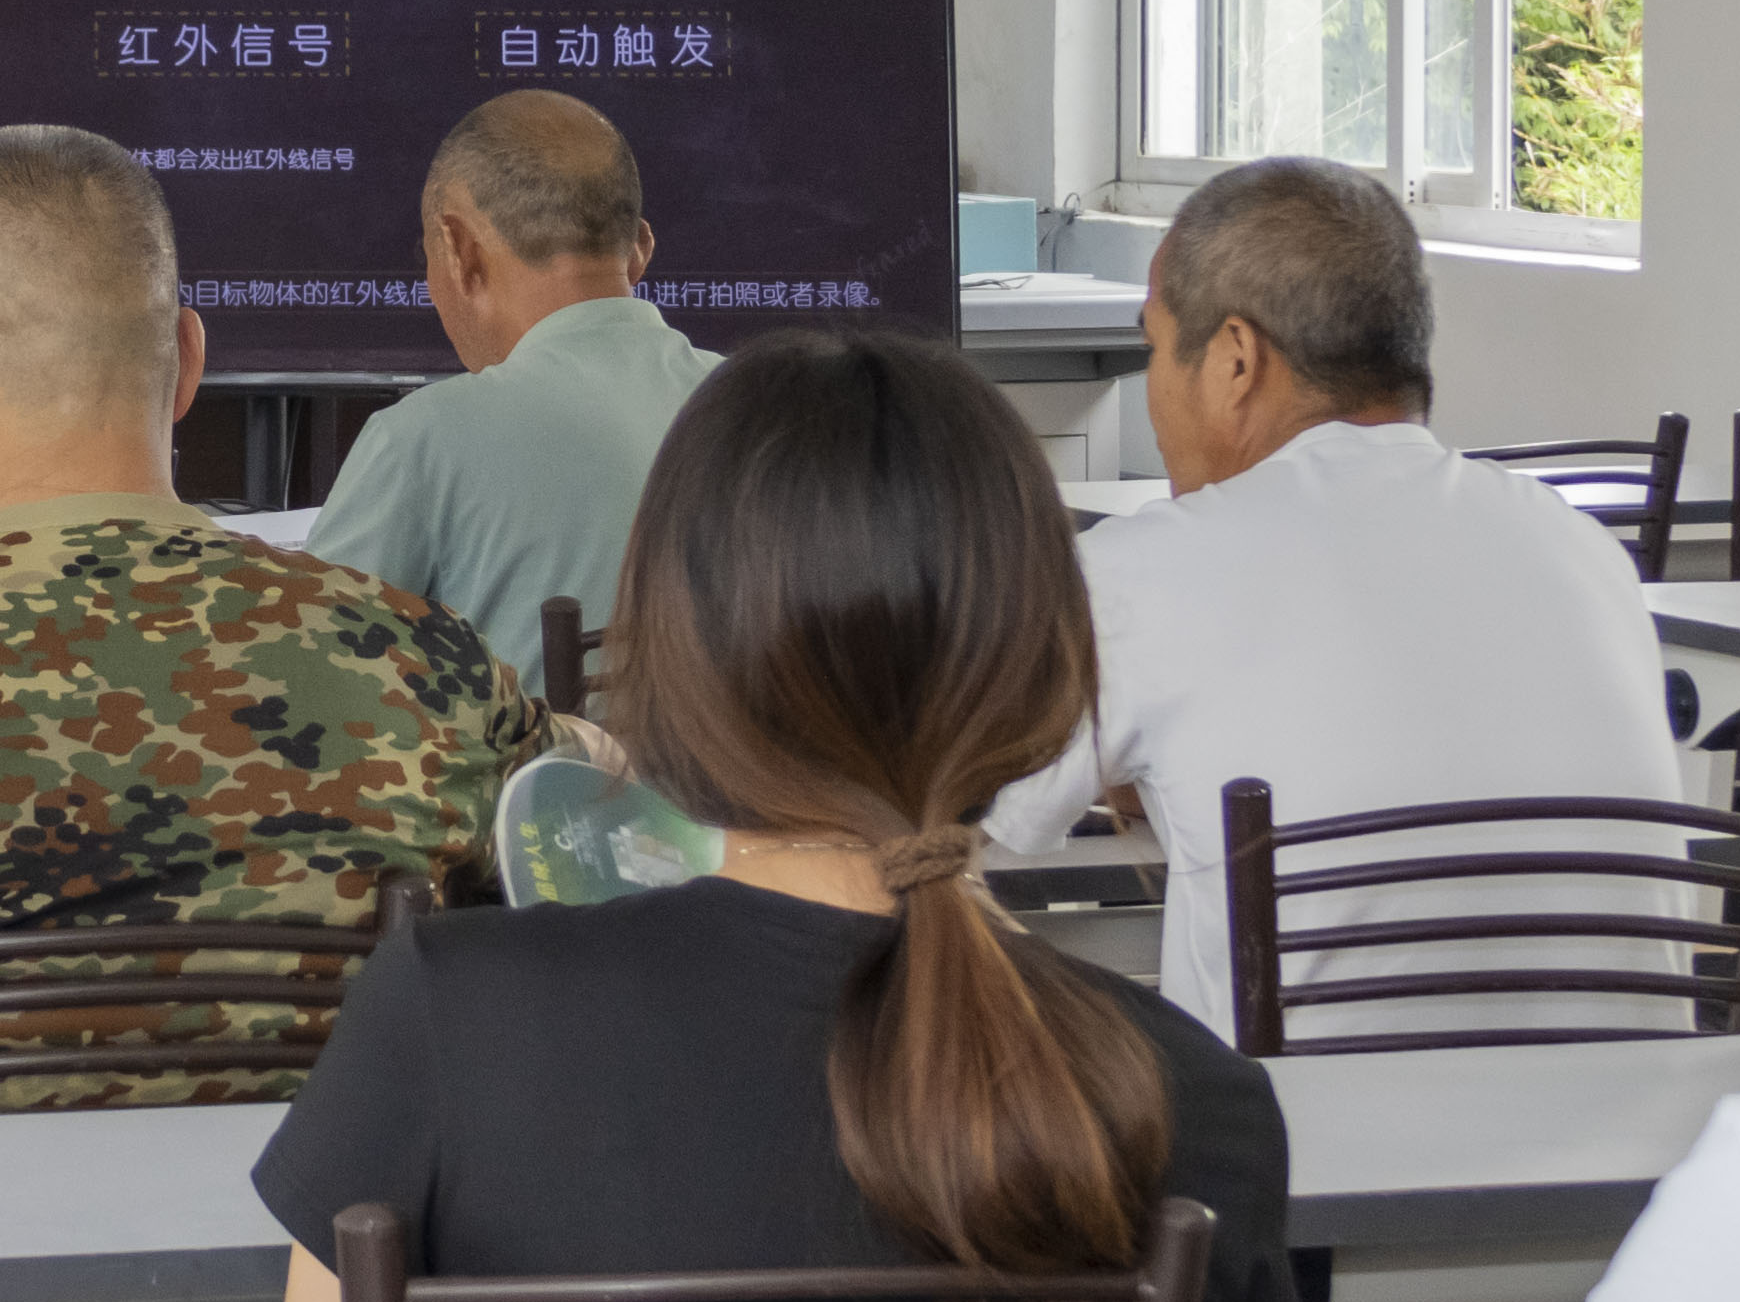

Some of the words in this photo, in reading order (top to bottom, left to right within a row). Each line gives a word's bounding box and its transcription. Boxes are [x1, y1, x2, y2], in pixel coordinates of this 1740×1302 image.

[117, 22, 333, 68] 红外信号
[500, 23, 714, 68] 自动触发
